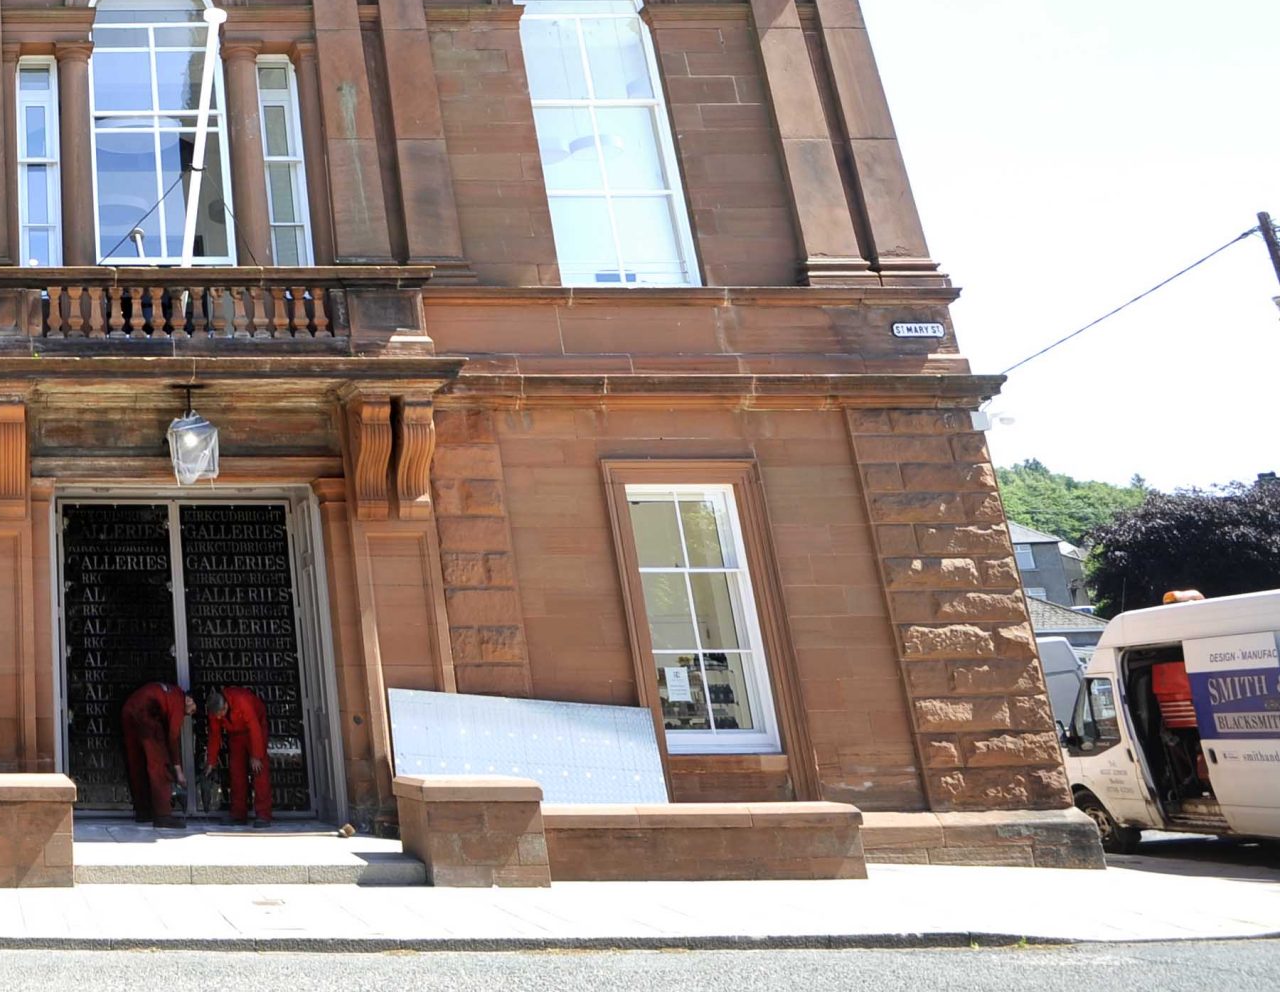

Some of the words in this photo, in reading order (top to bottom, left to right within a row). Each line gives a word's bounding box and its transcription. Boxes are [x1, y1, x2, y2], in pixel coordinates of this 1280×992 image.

[906, 325, 929, 334] MARY
[184, 523, 284, 540] GALLERIES
[186, 555, 286, 571] GALLERIES
[1209, 652, 1235, 663] DESIGN
[1208, 675, 1268, 705] SMITH
[1217, 714, 1280, 729] BLACKSMIT
